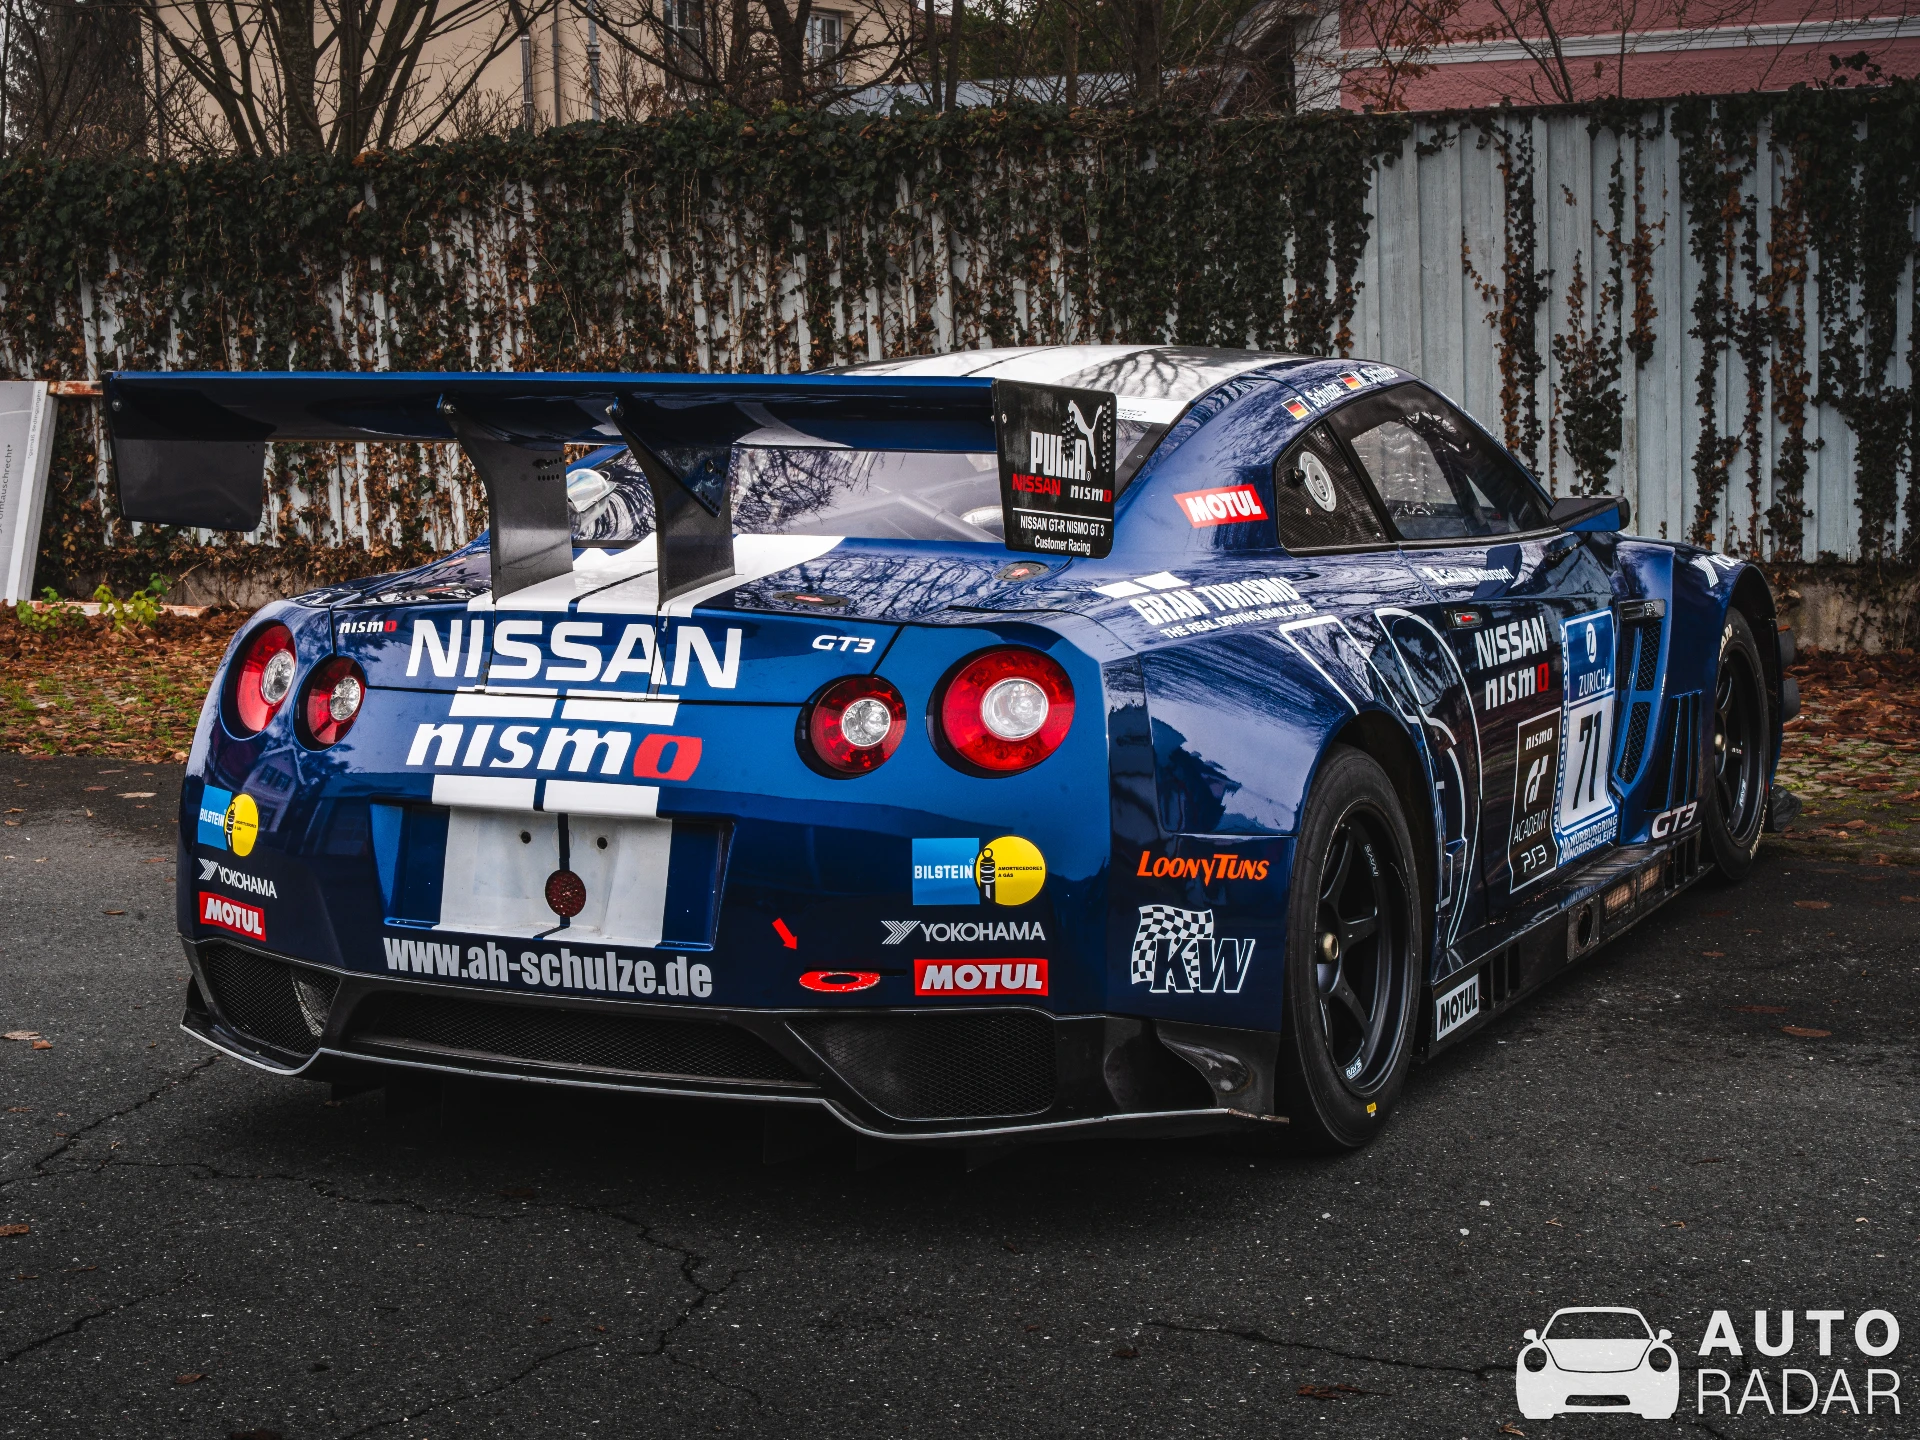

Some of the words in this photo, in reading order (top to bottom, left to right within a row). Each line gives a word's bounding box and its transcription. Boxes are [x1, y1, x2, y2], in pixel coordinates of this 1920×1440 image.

[1304, 383, 1345, 408] Schulze
[1030, 431, 1087, 480] PUMA
[1012, 473, 1061, 496] NISSAN
[1070, 485, 1112, 503] nismo
[1185, 490, 1262, 522] MOTUL
[1020, 515, 1048, 530] NISSAN
[1048, 518, 1066, 533] GT-R
[1066, 520, 1089, 533] NISMO
[1089, 522, 1100, 536] GT
[1034, 535, 1067, 550] Customer
[1068, 538, 1091, 555] Racing
[1129, 590, 1210, 626] GRAN
[1193, 577, 1300, 611] TURISMO
[339, 620, 398, 634] nismo
[1160, 626, 1189, 639] THE
[1185, 620, 1220, 634] REAL
[1214, 612, 1262, 628] DRIVING
[1255, 603, 1316, 620] SIMULATOR
[405, 619, 742, 689] NISSAN
[812, 635, 876, 653] GT3
[1474, 616, 1548, 670] NISSAN
[1485, 662, 1549, 710] nismo
[1579, 668, 1606, 697] ZURICH
[405, 723, 702, 781] nismo
[1573, 710, 1602, 810] 71
[200, 807, 226, 827] BILSTEIN
[1513, 808, 1549, 844] ACADEMY
[1570, 814, 1618, 847] NÜRBURGRING
[1652, 802, 1698, 840] GT3
[1570, 826, 1617, 859] NORDSCHLEIFE
[218, 865, 278, 898] YOKOHAMA
[914, 865, 973, 879] BILSTEIN
[205, 897, 263, 936] MOTUL
[920, 921, 1046, 942] YOKOHAMA
[383, 937, 713, 998] www.ah-schulze.de
[921, 964, 1043, 990] MOTUL
[1149, 938, 1256, 993] KW
[1439, 983, 1477, 1033] MOTUL
